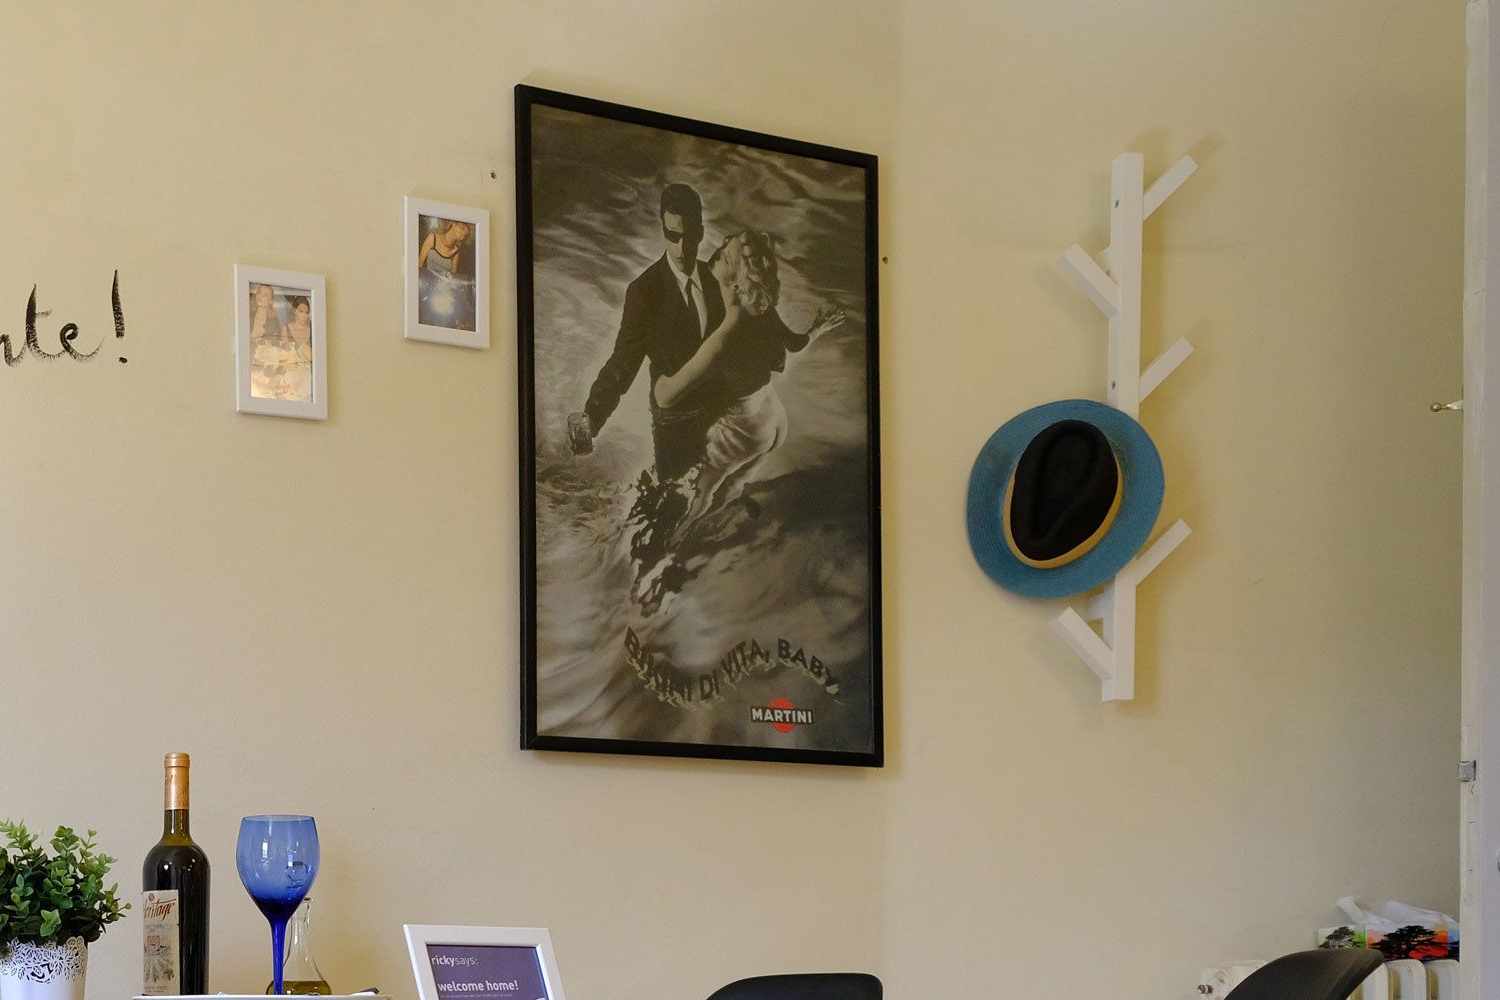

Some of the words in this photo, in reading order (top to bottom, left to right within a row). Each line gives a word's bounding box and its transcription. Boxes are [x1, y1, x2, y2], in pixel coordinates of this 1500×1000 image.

[777, 637, 840, 688] BABY
[751, 707, 813, 724] MARTINI
[431, 955, 479, 967] rickysays:
[438, 981, 485, 992] welcome
[486, 980, 519, 991] home!
